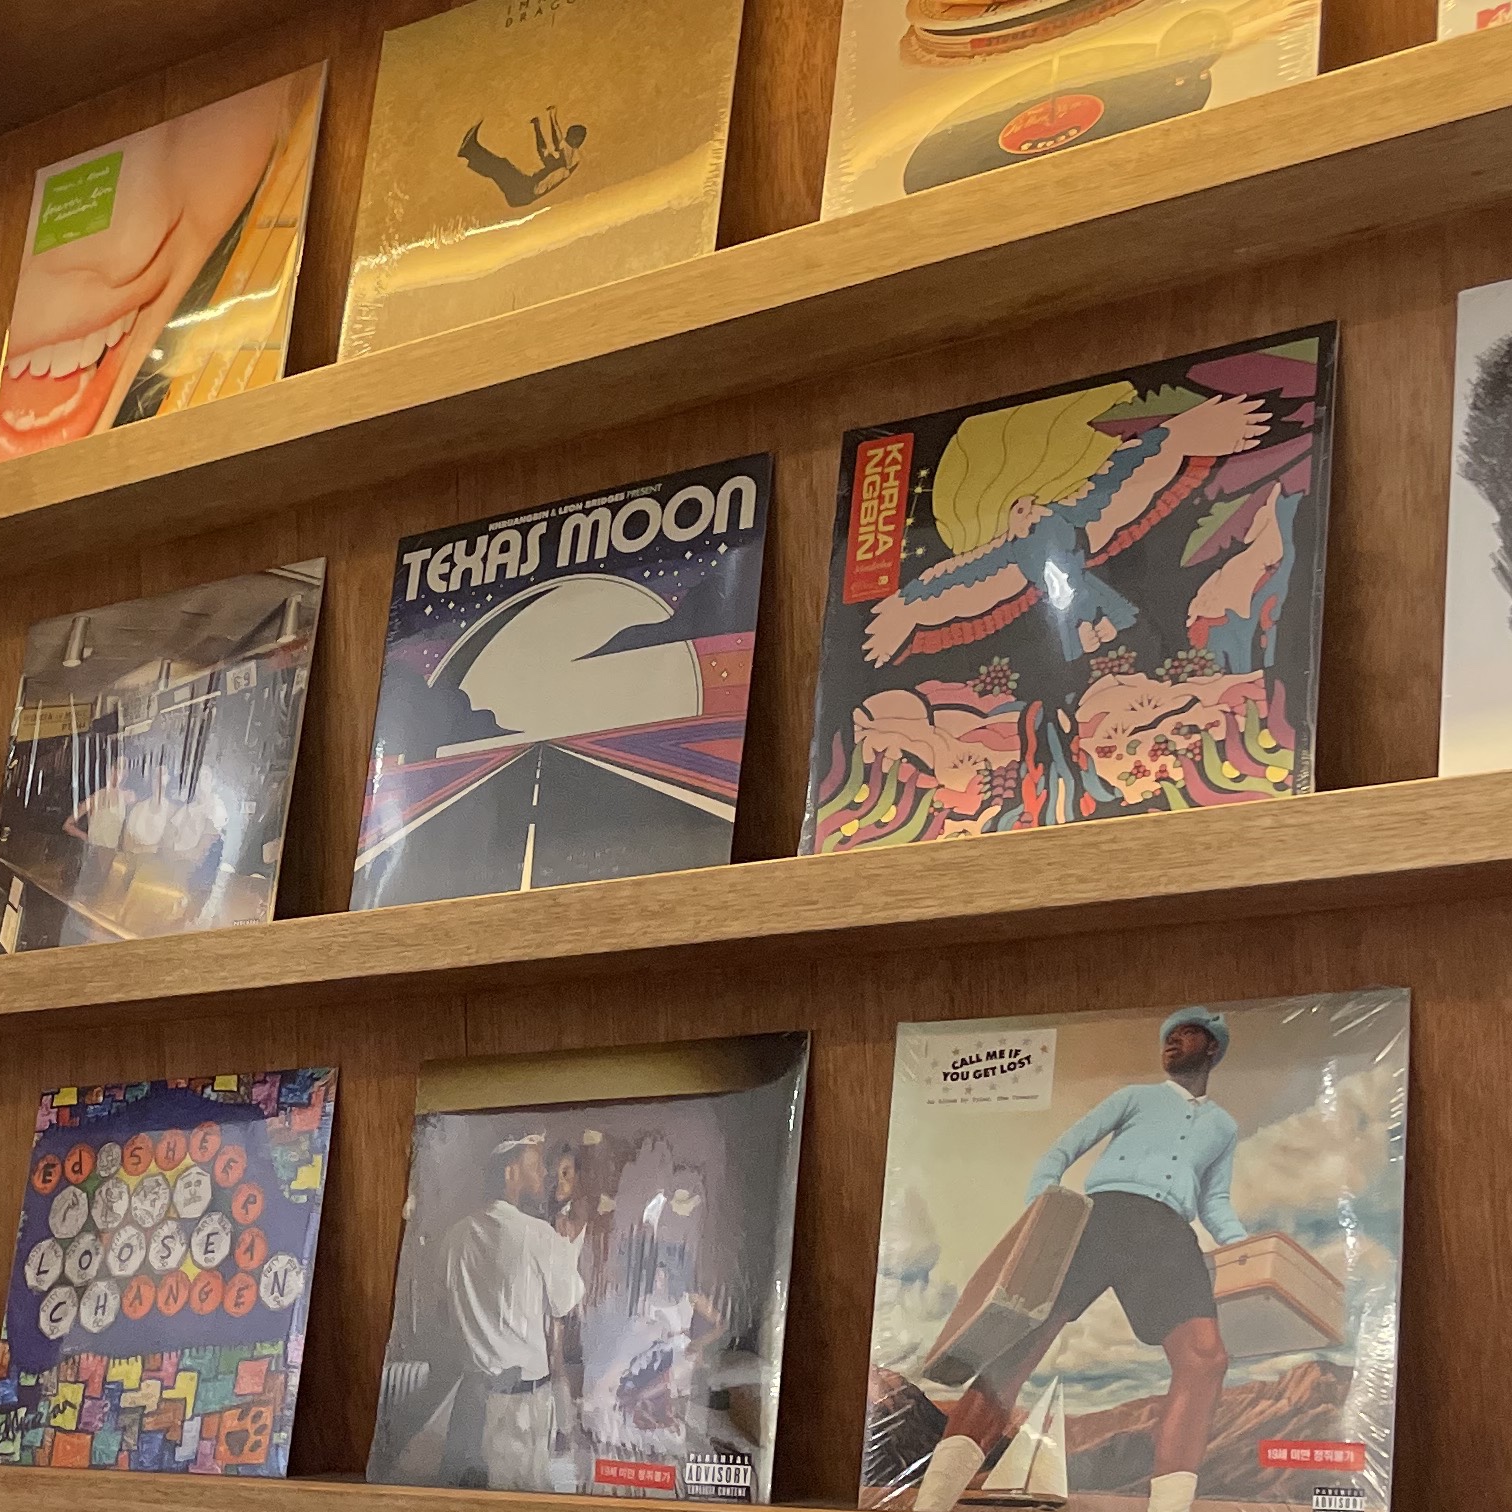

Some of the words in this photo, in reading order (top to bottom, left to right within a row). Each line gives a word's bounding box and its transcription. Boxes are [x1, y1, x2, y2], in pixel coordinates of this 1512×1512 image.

[558, 502, 583, 515] LEON
[584, 492, 626, 508] BRIDGES
[626, 483, 663, 499] PRESENT
[856, 447, 885, 561] NGBIN
[875, 442, 905, 557] KHRUA
[402, 521, 548, 601] TEXAS
[556, 475, 757, 568] MOON
[942, 1070, 970, 1082] YOU
[972, 1066, 997, 1080] GET
[999, 1054, 1032, 1074] LOST
[951, 1053, 982, 1070] CALL
[985, 1049, 1006, 1061] ME
[1008, 1048, 1022, 1059] IF
[35, 1230, 223, 1278] LOOSE
[49, 1279, 249, 1324] CHANGE
[687, 1465, 750, 1484] ADVISORY
